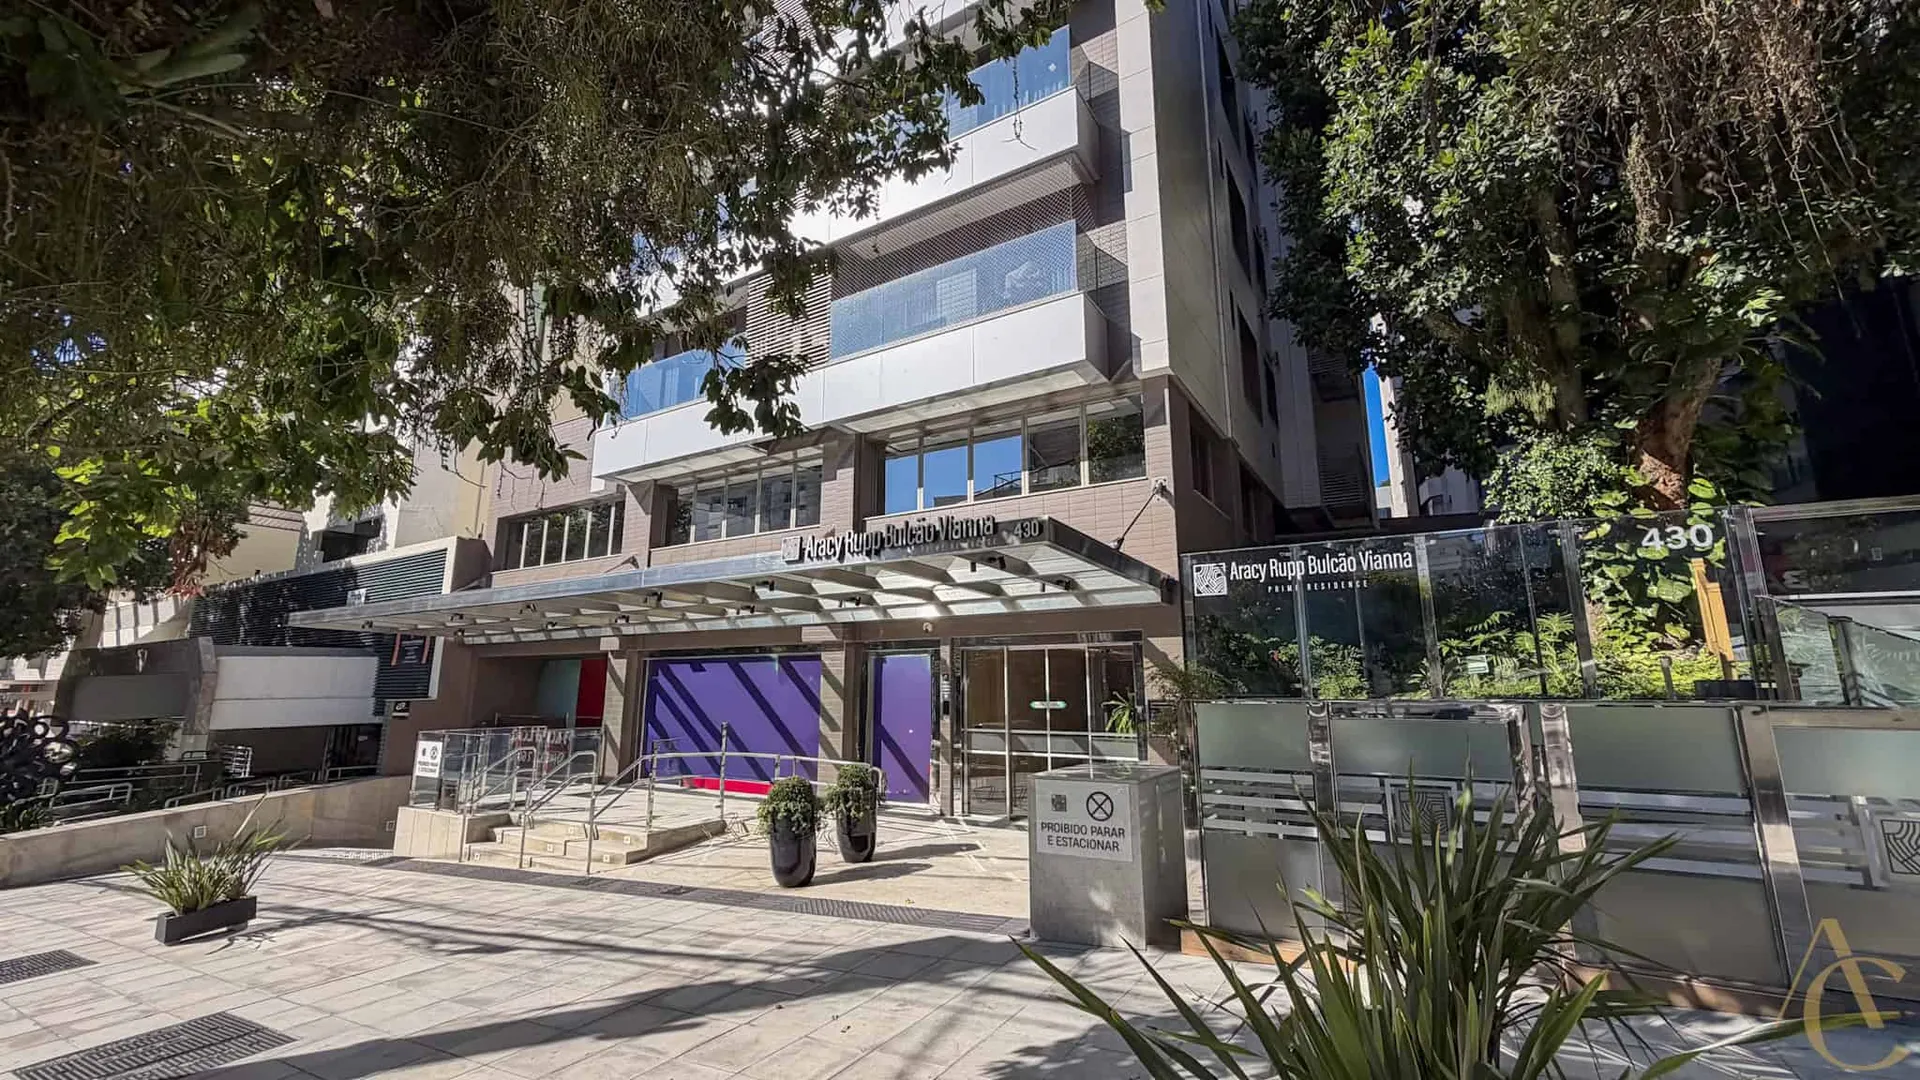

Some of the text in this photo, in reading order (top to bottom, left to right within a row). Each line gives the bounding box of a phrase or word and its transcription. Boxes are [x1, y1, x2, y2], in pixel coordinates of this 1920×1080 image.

[804, 534, 845, 560] Aracy
[846, 530, 883, 558] Rupp
[885, 517, 936, 548] Bulcão
[937, 515, 995, 541] Vianna
[1014, 519, 1040, 539] 430
[1641, 524, 1714, 550] 430
[1230, 550, 1413, 583] Aracy Rupp Bulcão Vianna
[1306, 580, 1368, 591] RESIDENCE
[1041, 822, 1126, 839] PROIBIDO PARAR
[1047, 835, 1120, 852] E ESTACIONAR
